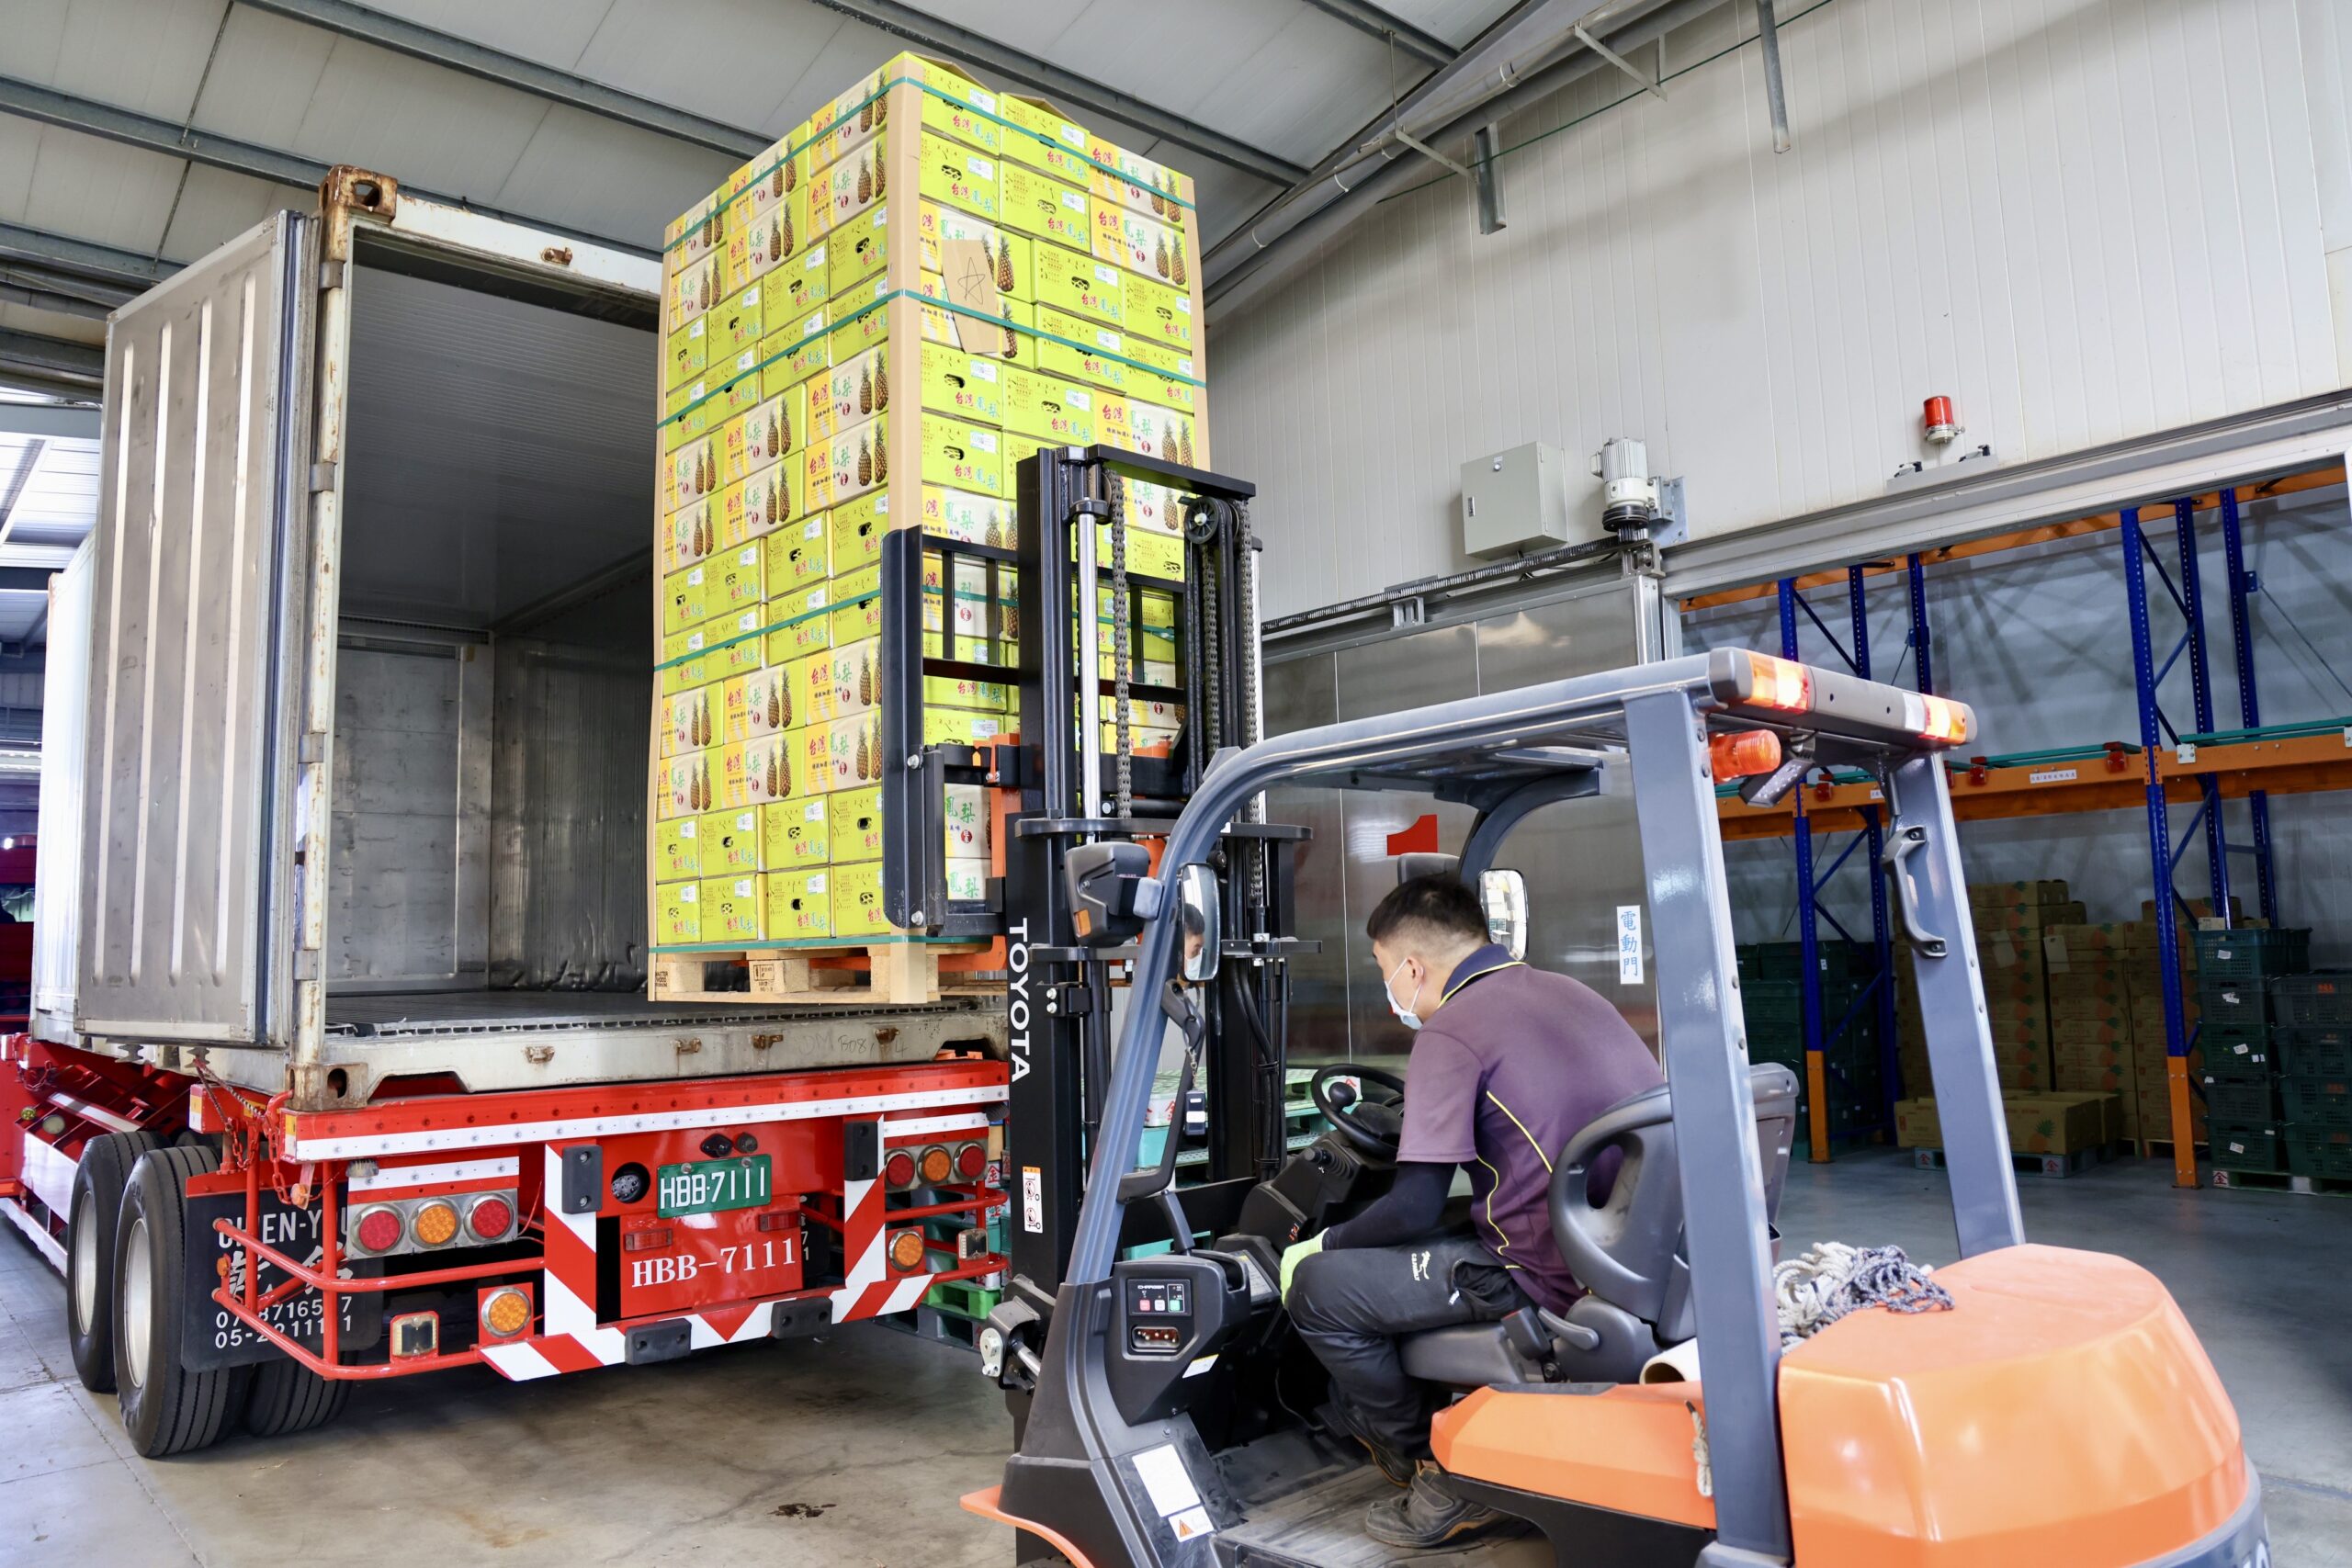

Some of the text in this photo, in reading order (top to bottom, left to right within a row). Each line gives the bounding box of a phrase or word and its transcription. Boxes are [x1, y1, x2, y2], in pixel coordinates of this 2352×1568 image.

[1102, 404, 1153, 437] 台灣鳳梨
[1621, 909, 1639, 977] 電動門
[1009, 918, 1031, 1083] TOYOTA
[632, 1237, 797, 1288] HBB-7111
